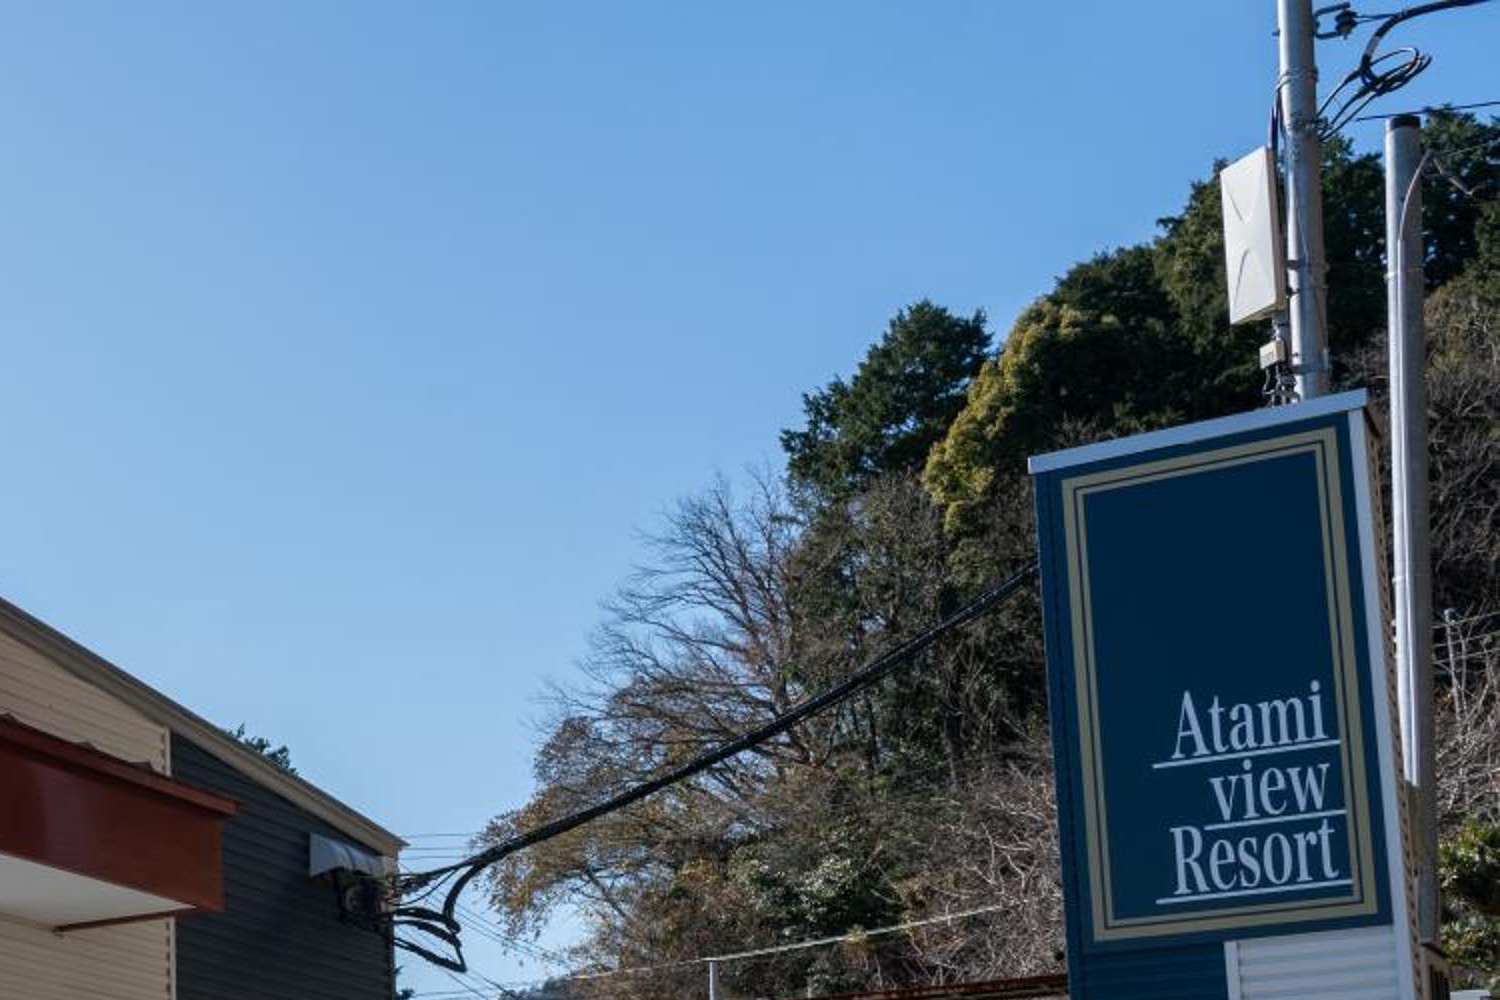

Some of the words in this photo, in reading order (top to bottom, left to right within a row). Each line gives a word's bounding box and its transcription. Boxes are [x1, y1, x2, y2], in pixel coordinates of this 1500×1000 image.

[1171, 679, 1329, 759] Atami
[1209, 759, 1331, 821] view
[1169, 818, 1340, 895] Resort
